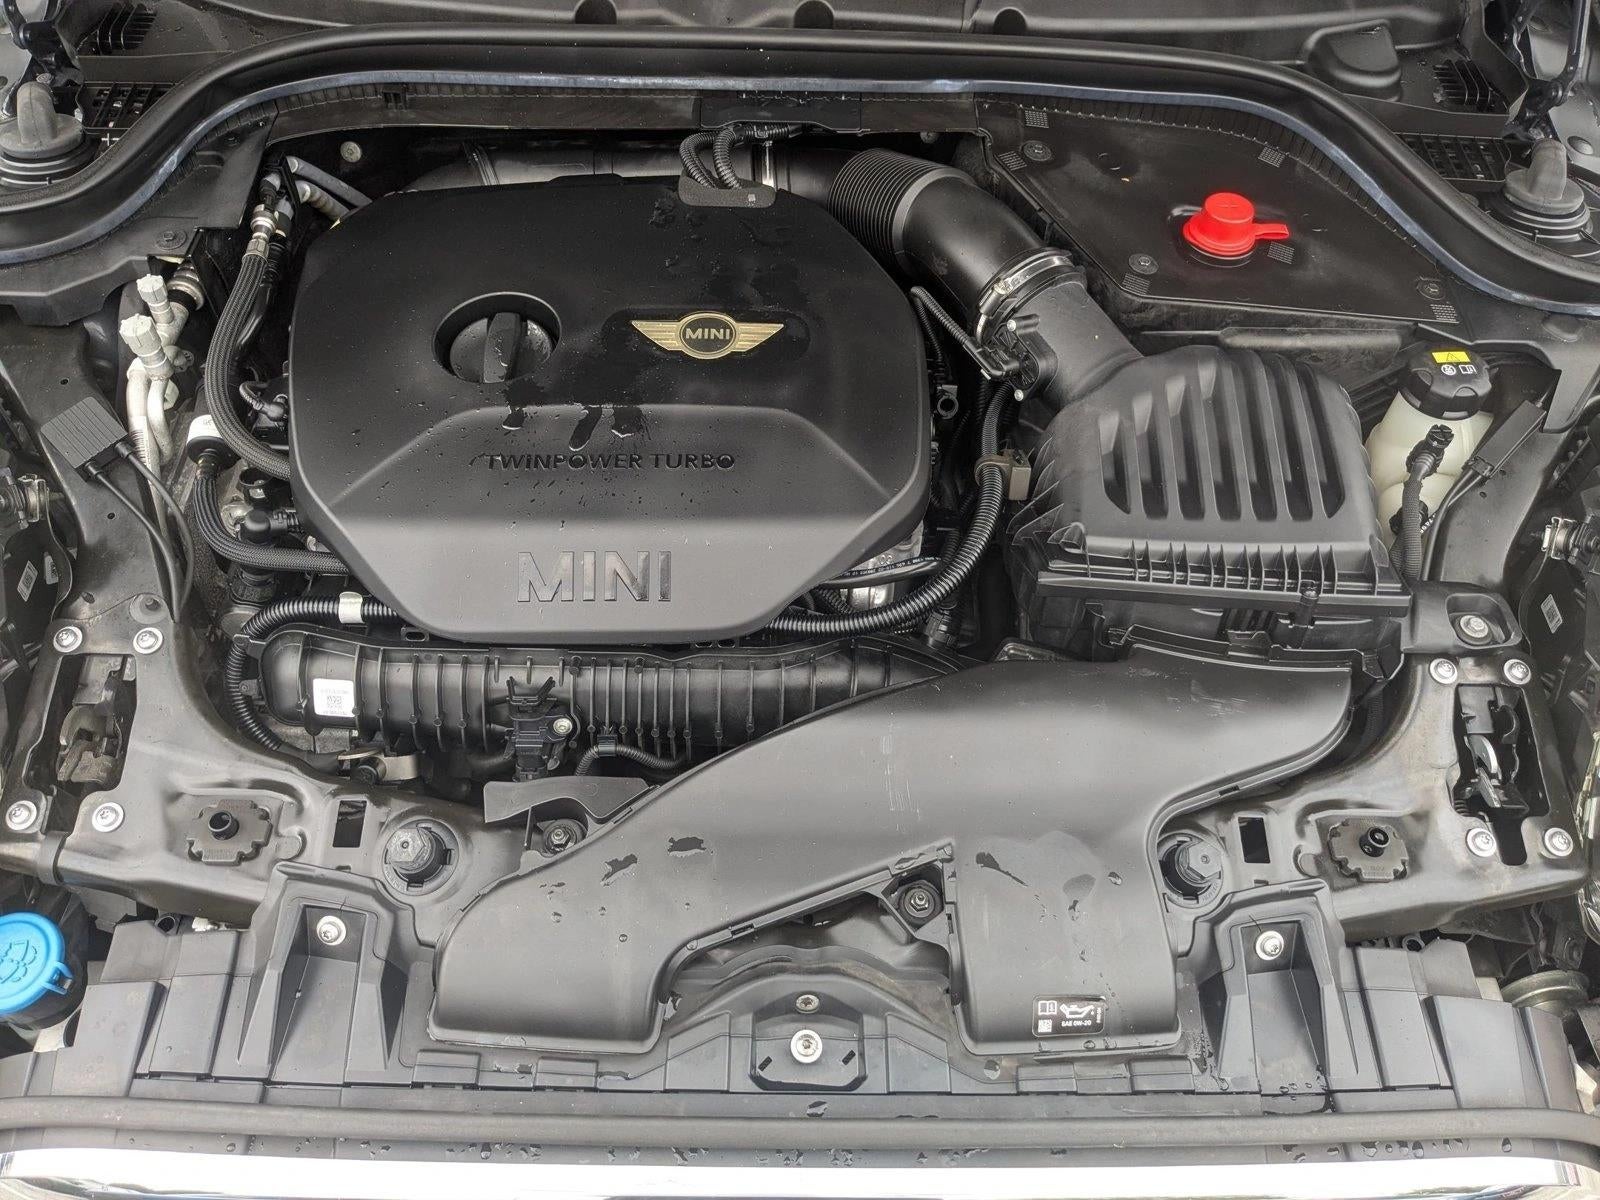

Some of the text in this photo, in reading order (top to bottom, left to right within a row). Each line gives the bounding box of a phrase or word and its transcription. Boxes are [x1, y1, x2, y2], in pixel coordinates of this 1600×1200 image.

[685, 327, 731, 340] MINI
[484, 453, 735, 470] TWINPOWER TURBO
[517, 551, 672, 602] MINI
